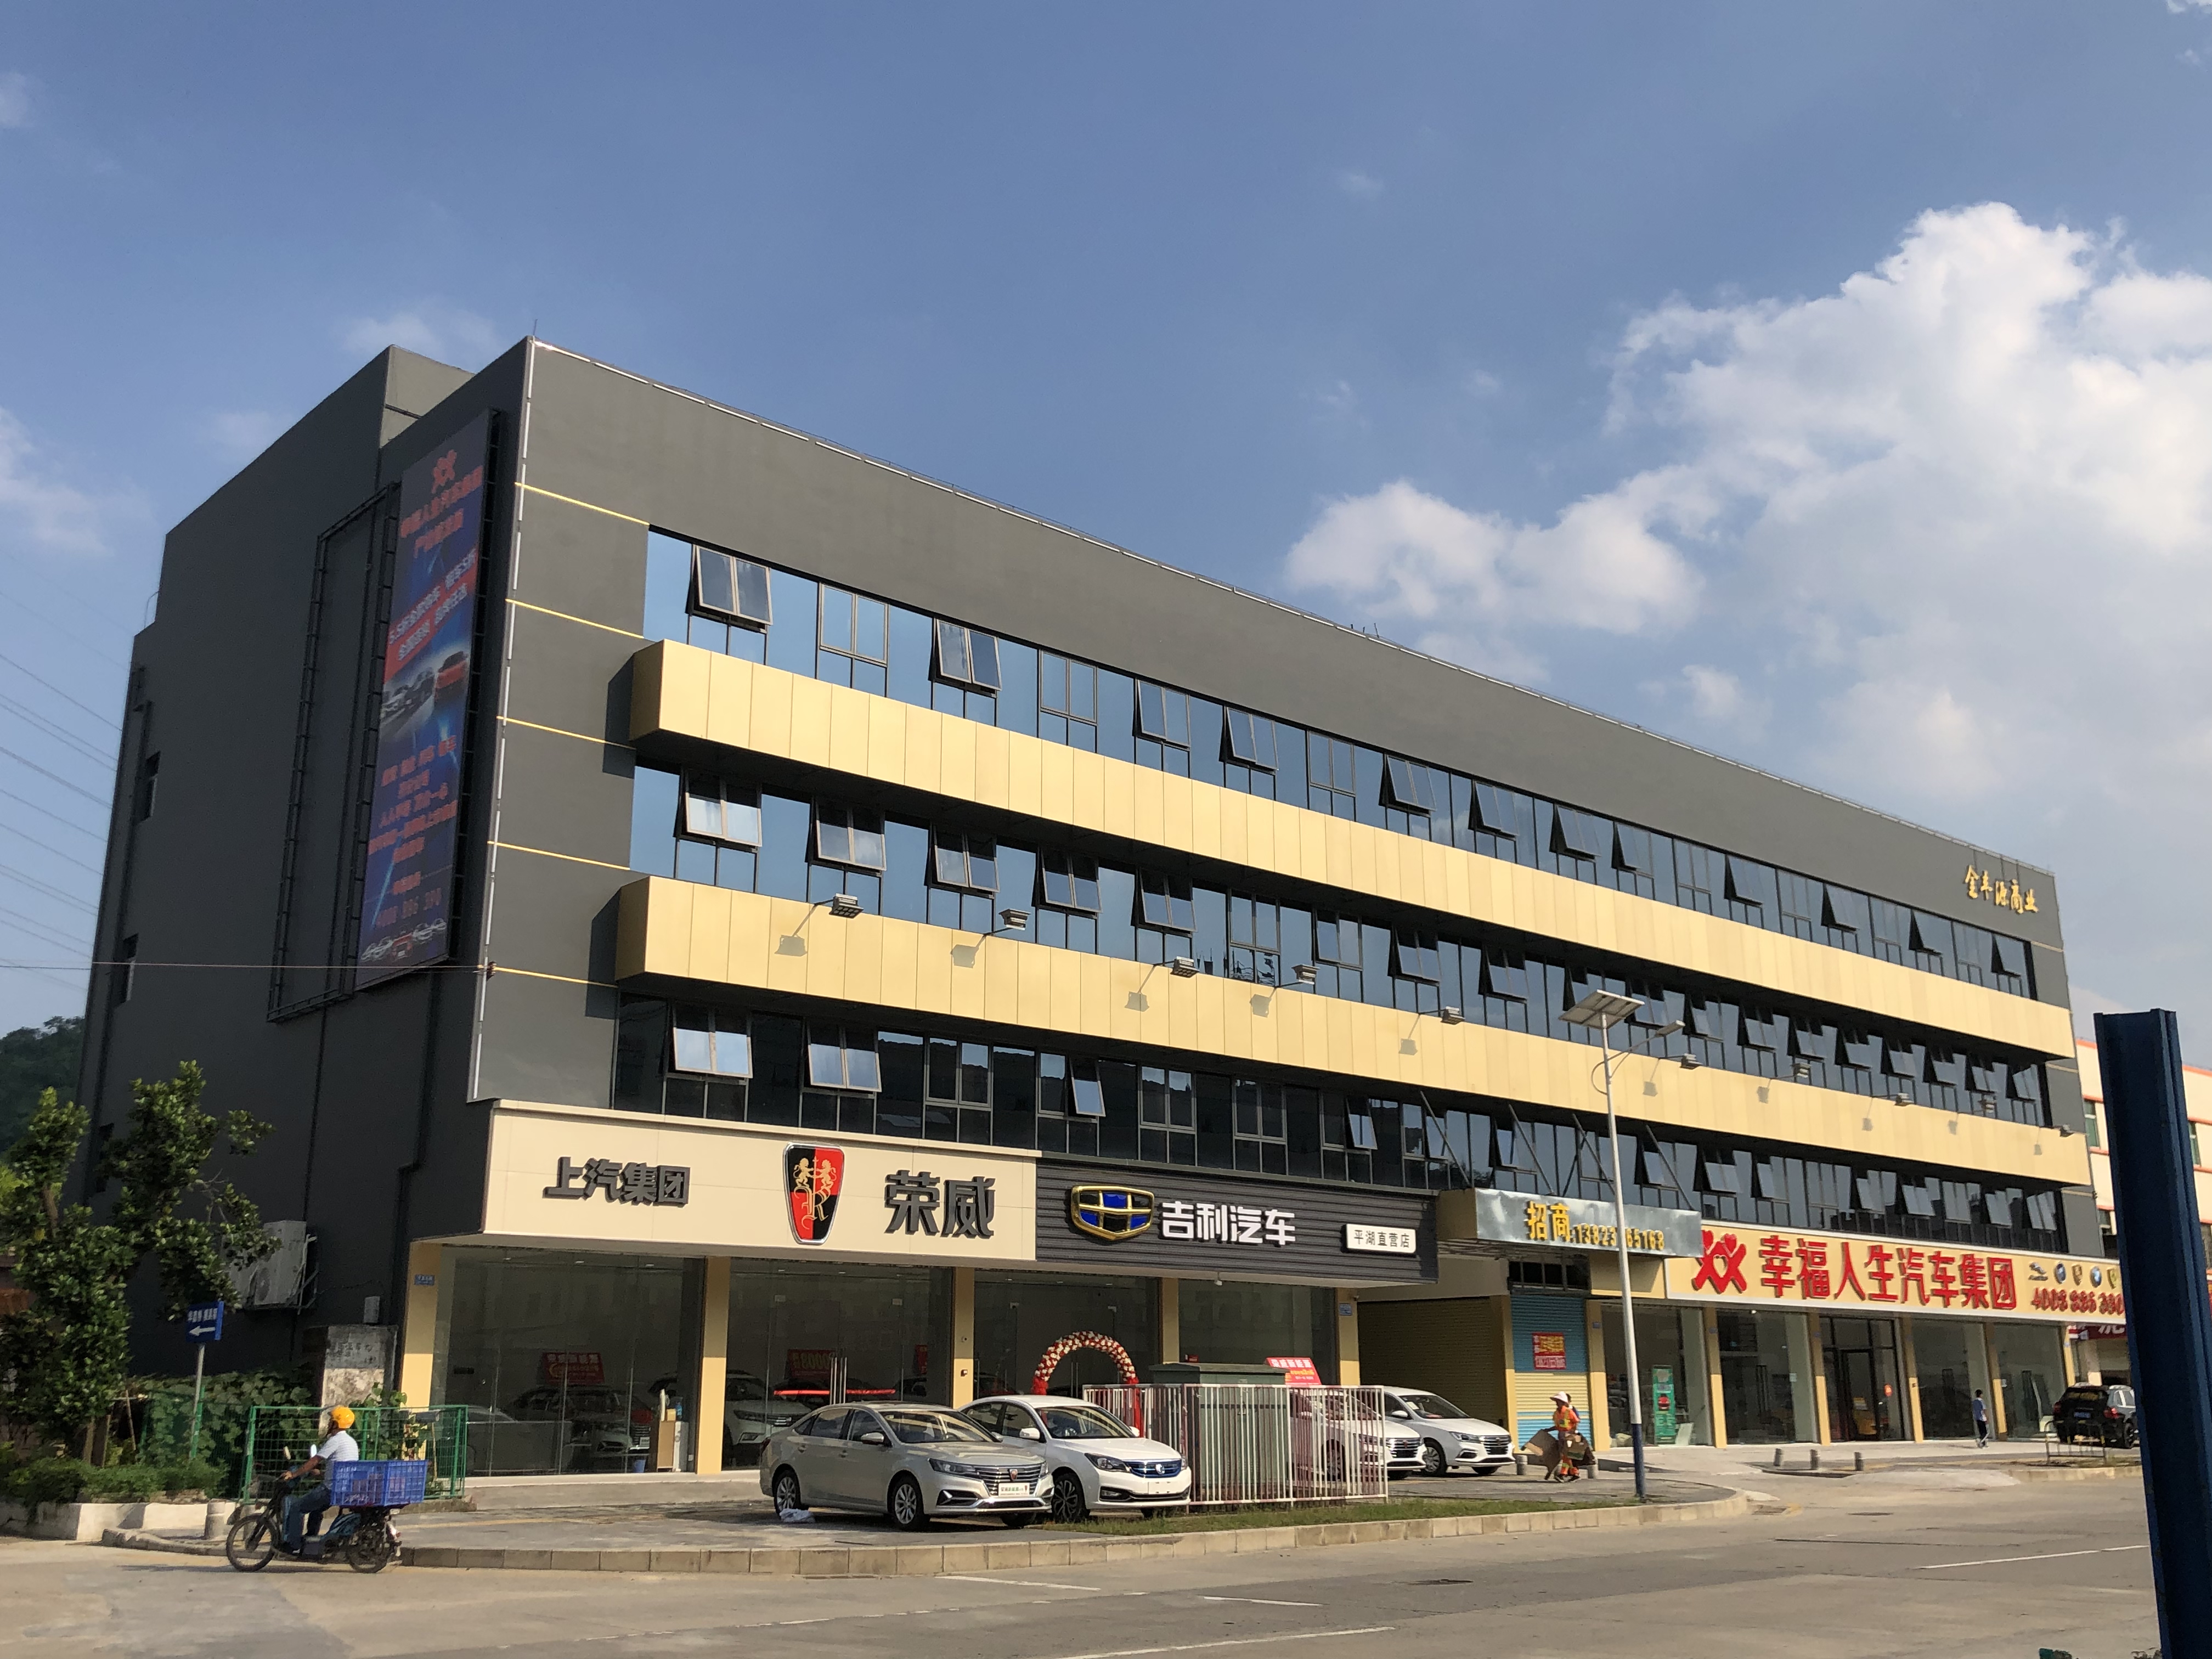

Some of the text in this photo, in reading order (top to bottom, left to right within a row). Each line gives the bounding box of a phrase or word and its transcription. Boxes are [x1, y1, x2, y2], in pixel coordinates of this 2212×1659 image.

[542, 1155, 691, 1207] 上汽集团
[884, 1170, 996, 1239] 荣威
[1162, 1200, 1296, 1246] 吉利汽车
[1353, 1229, 1410, 1248] 平湖直营店
[1527, 1200, 1664, 1251] 招商 :1382365168
[1759, 1235, 2017, 1311] 幸福人生汽车集团
